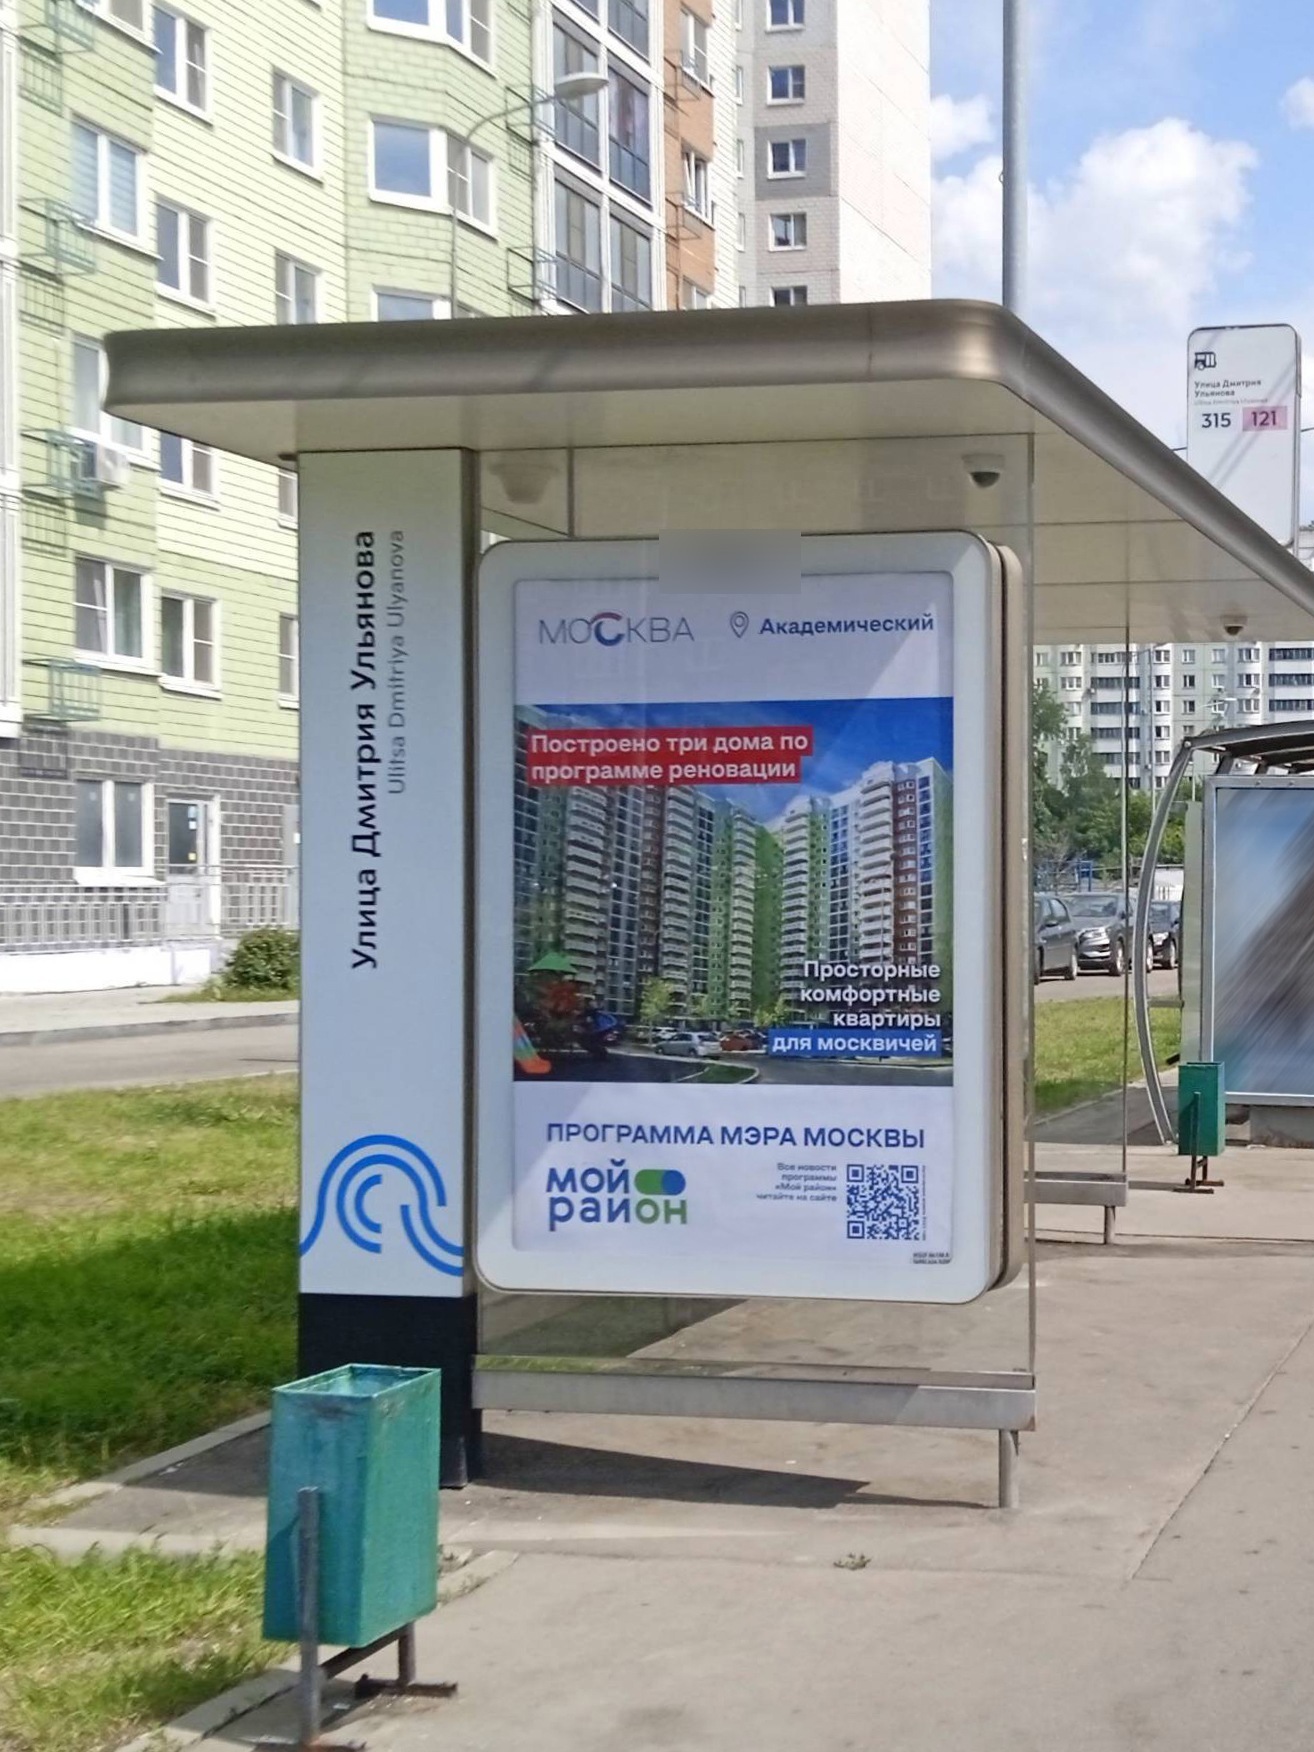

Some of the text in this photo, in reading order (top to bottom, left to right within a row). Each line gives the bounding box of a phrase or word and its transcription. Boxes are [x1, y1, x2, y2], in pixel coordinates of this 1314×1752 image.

[1194, 379, 1261, 389] Улица Дмитрия
[1194, 390, 1235, 398] Ульянова
[1202, 412, 1231, 428] 315
[1251, 410, 1276, 427] 121
[538, 611, 694, 647] МОСКВА
[759, 613, 934, 637] Академический
[386, 530, 408, 795] Ulitsa Dmitriya Ulyanova
[350, 531, 381, 969] Улица Дмитрия Ульянова
[531, 735, 808, 756] Построено три дома по
[531, 761, 796, 785] программе реновации
[803, 960, 941, 982] Просторные
[801, 984, 940, 1007] комфортные
[833, 1010, 941, 1031] квартиры
[772, 1033, 937, 1053] для москвичей
[547, 1123, 924, 1149] ПРОГРАММА МЭРА МОСКВЫ
